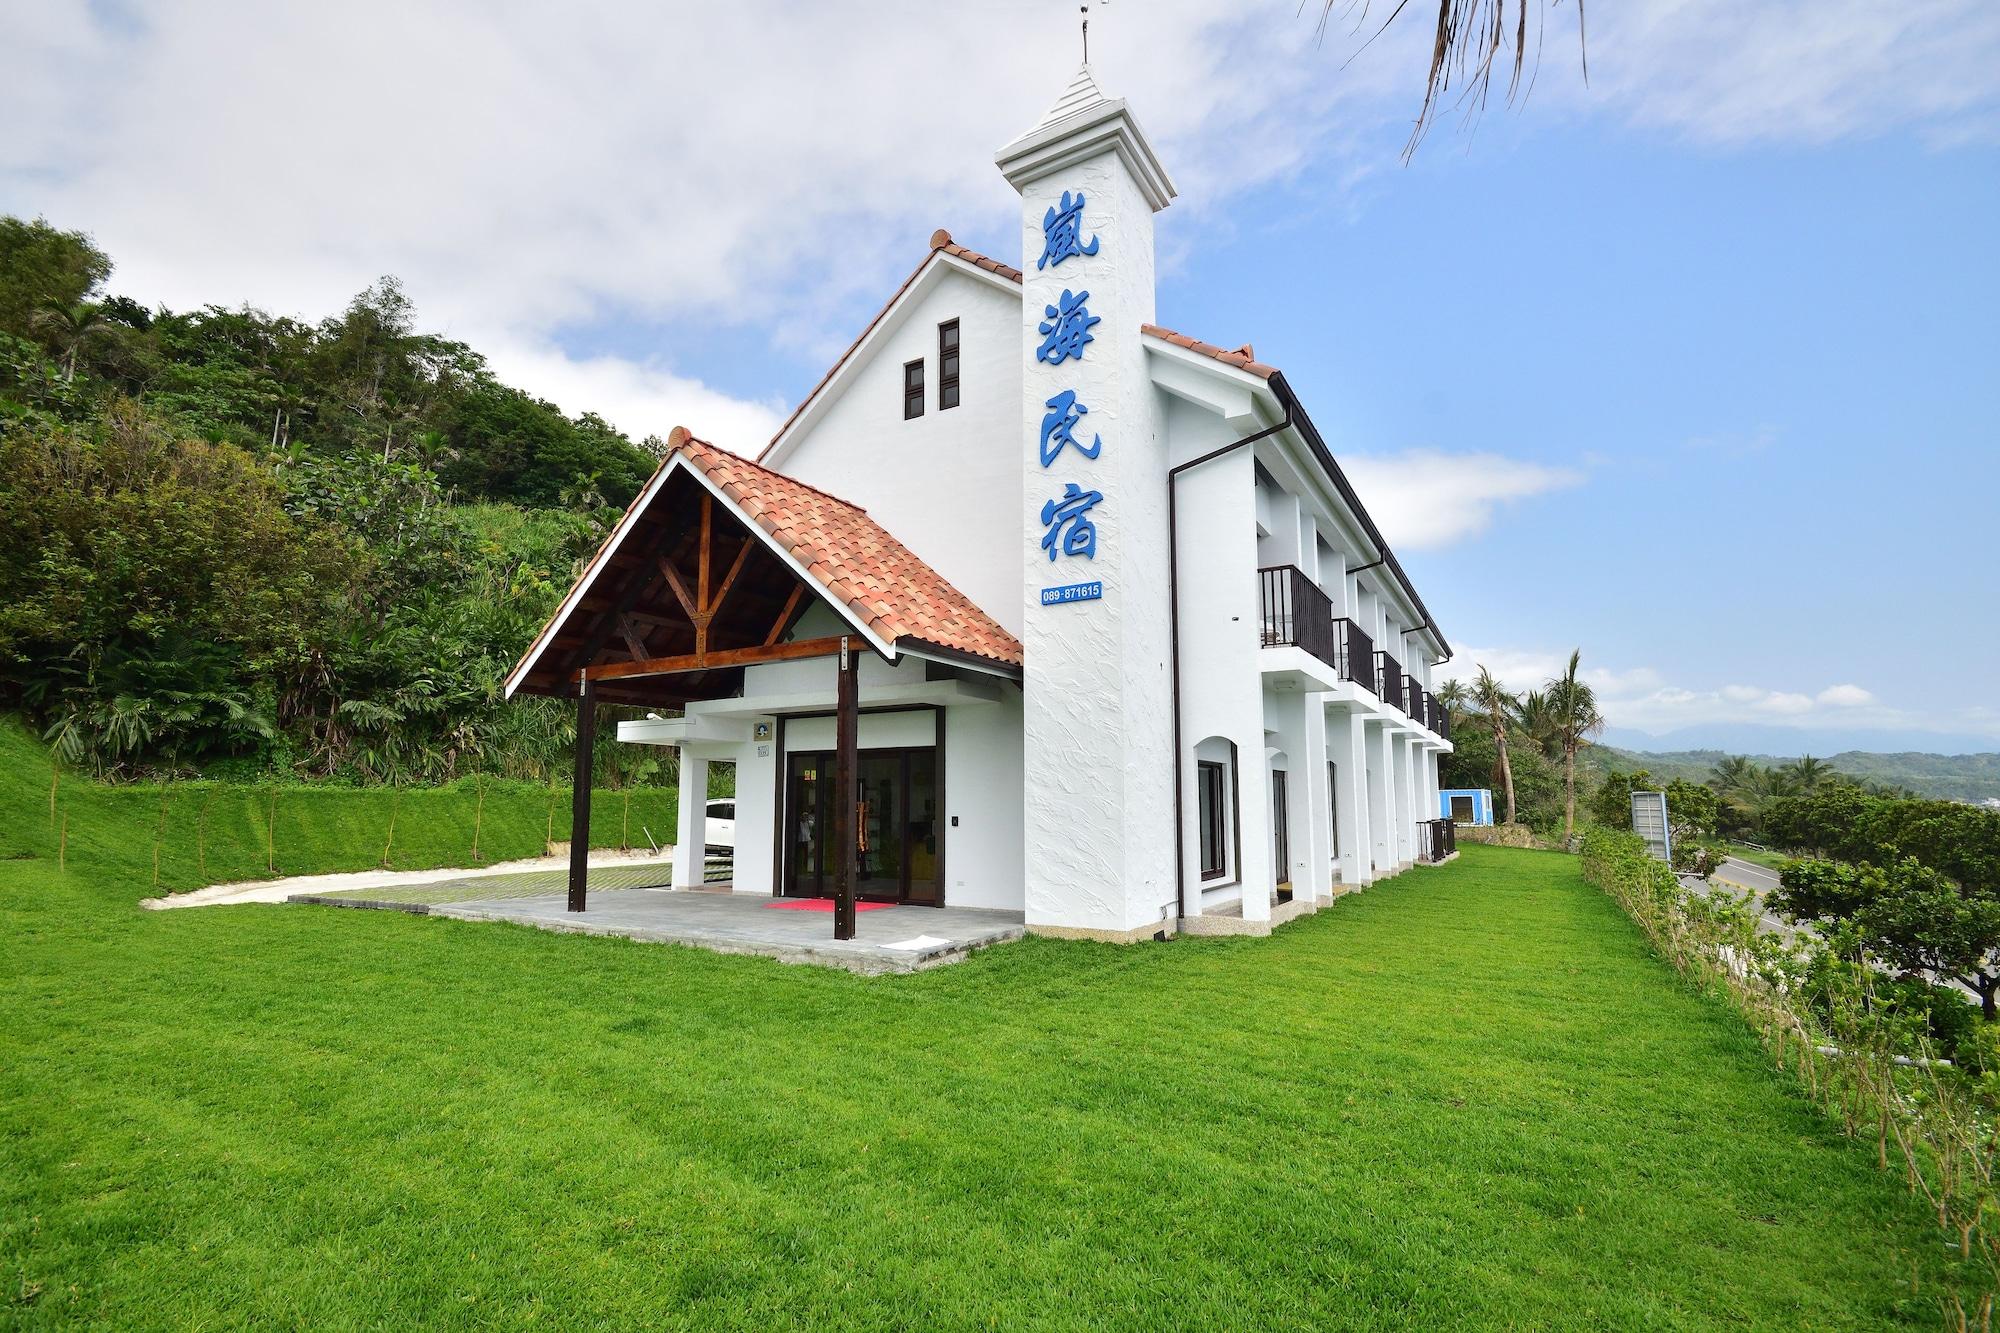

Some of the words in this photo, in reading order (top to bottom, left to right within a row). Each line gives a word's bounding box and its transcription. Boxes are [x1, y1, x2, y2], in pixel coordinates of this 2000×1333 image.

[1037, 190, 1103, 561] 嵐海民宿
[1043, 584, 1099, 601] 089-871615
